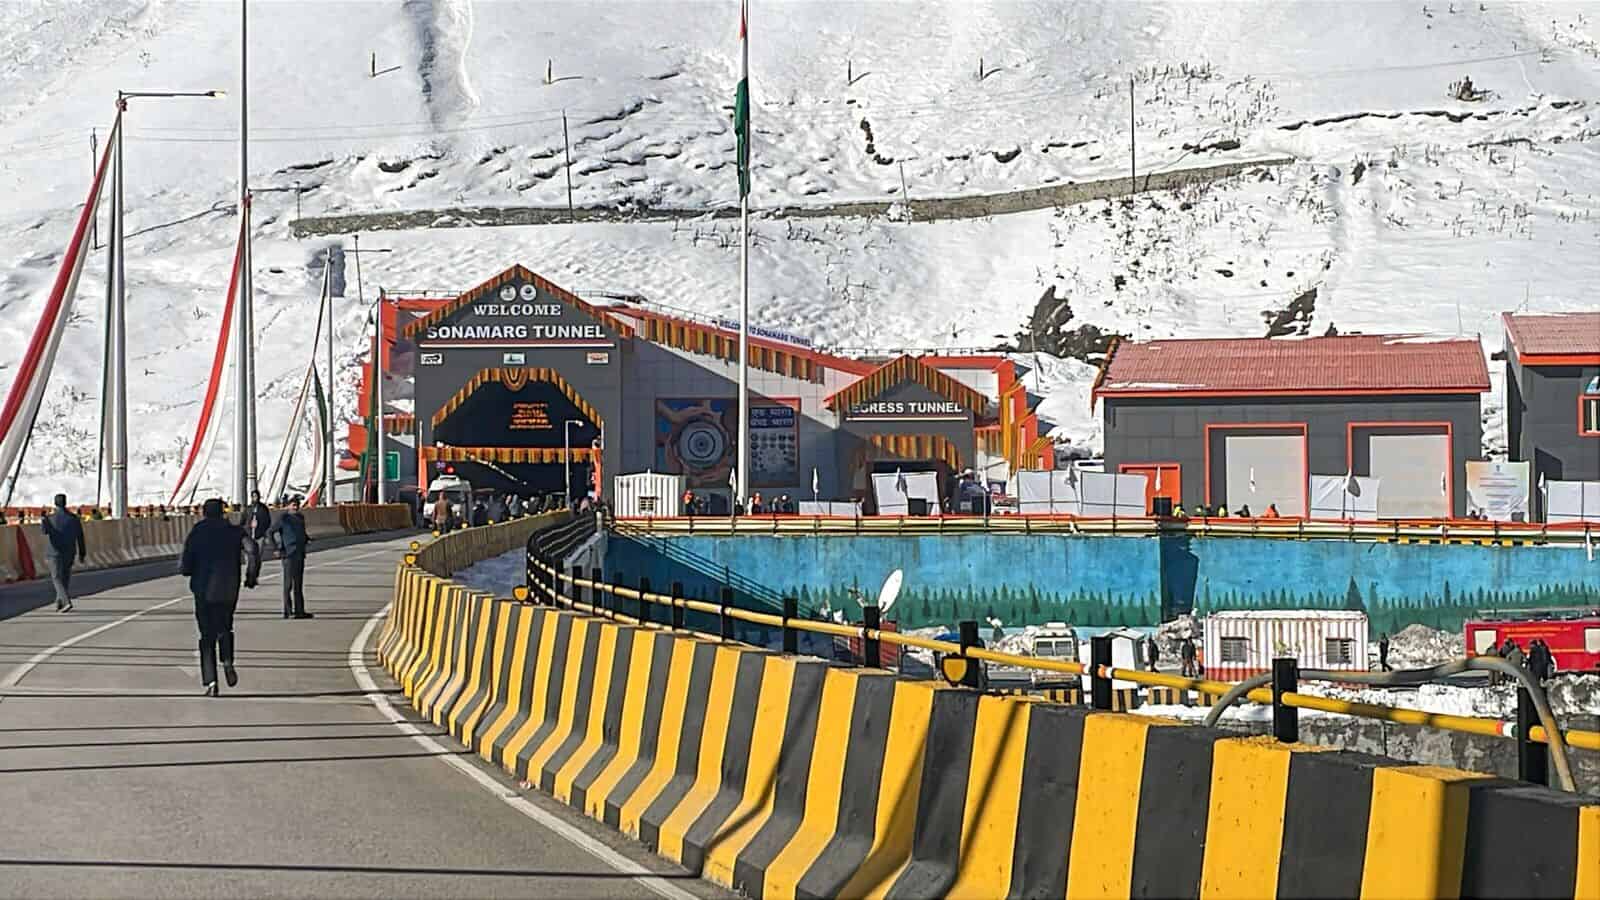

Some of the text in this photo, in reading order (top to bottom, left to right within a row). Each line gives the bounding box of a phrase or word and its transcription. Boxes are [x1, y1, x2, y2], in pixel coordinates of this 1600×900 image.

[473, 304, 561, 316] WELCOME
[427, 325, 606, 339] SONAMARG TUNNEL
[908, 402, 963, 413] TUNNEL
